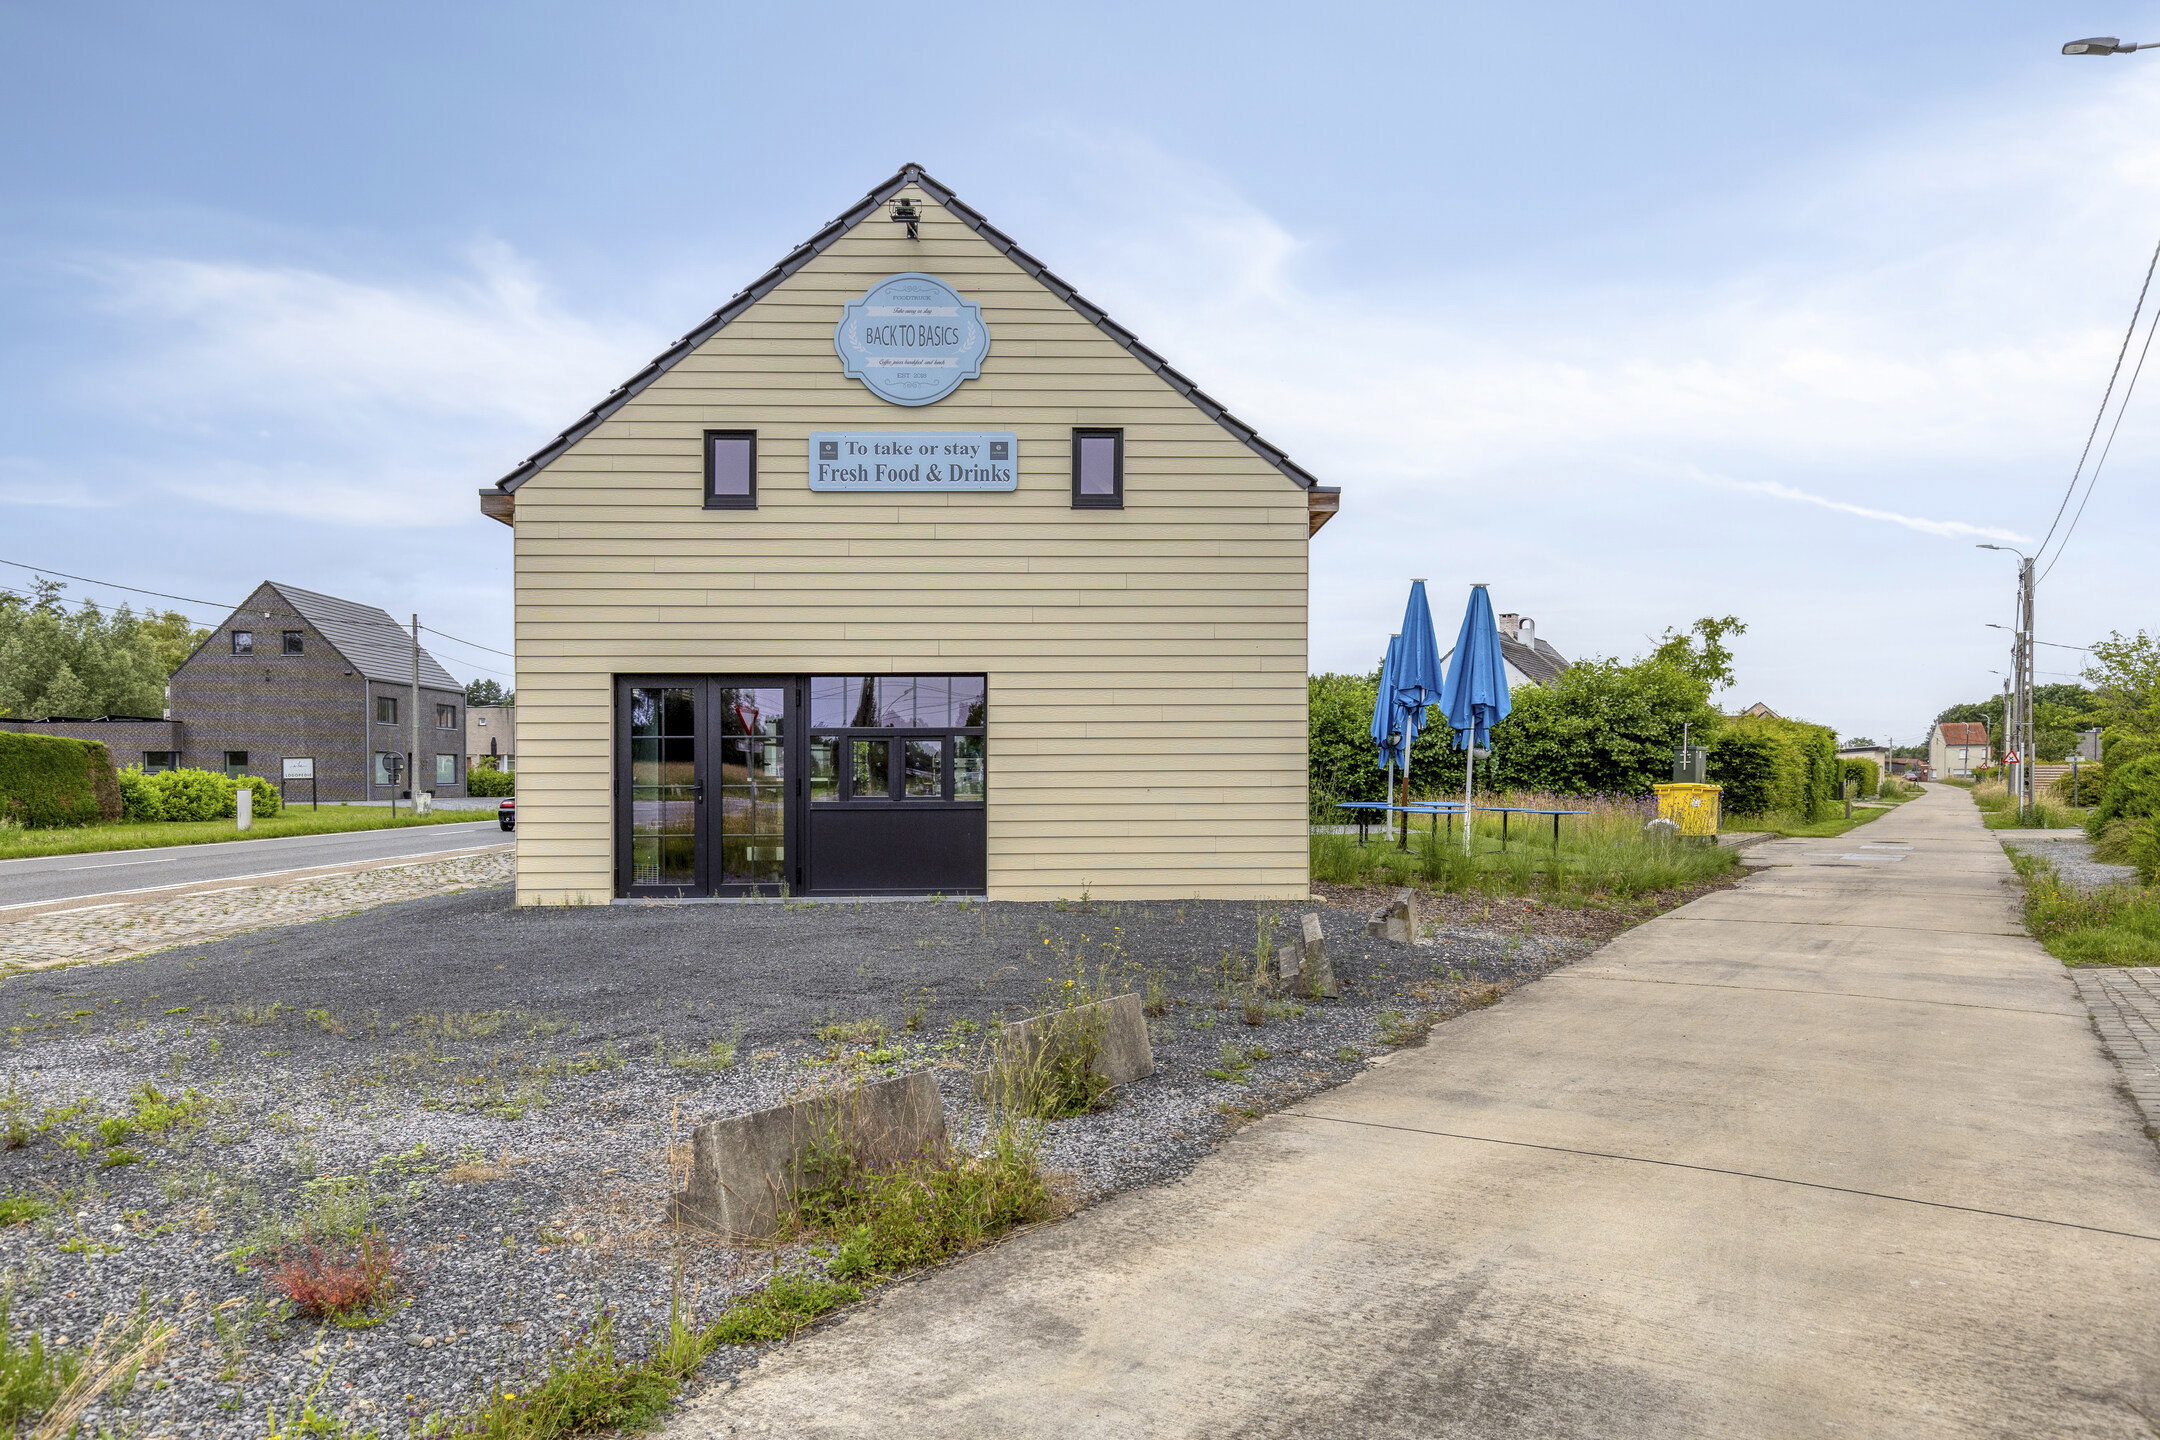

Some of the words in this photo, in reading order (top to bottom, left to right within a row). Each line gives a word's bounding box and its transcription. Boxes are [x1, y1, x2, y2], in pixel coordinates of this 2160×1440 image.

[866, 325, 897, 346] BACK
[899, 325, 915, 347] TO
[919, 325, 959, 347] BASICS
[845, 441, 868, 456] To
[874, 441, 914, 456] take
[919, 444, 939, 456] or
[944, 442, 981, 459] stay
[818, 463, 869, 482] Fresh
[875, 463, 920, 482] Food
[926, 463, 943, 482] &
[949, 463, 1011, 482] Drinks
